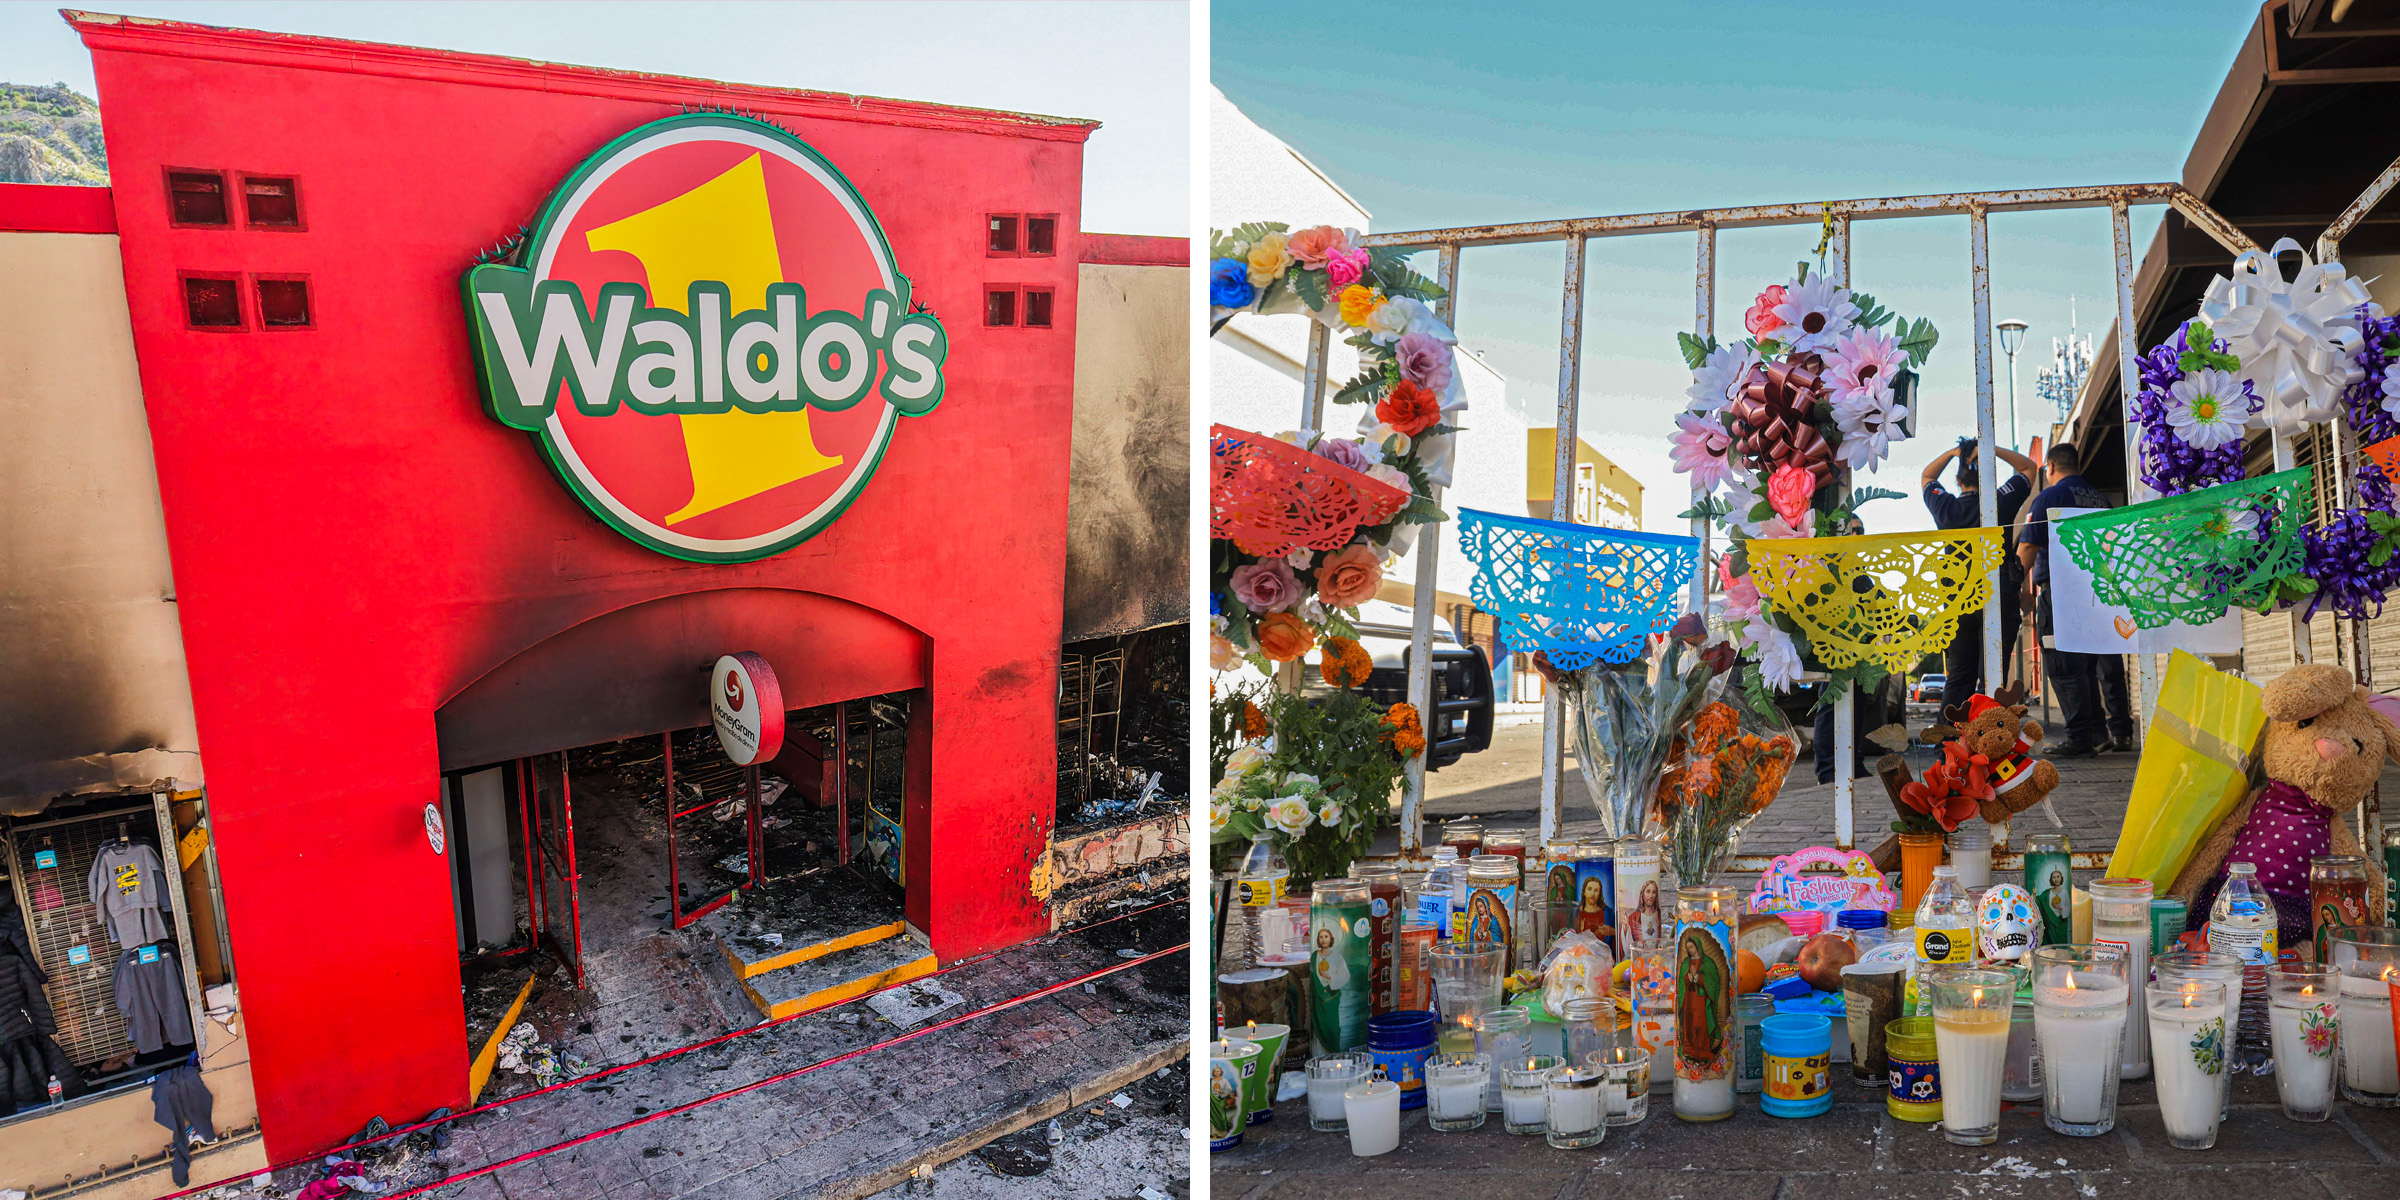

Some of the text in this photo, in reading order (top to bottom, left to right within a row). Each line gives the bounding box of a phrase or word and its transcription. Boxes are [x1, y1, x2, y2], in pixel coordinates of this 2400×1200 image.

[585, 151, 843, 526] 1
[477, 292, 938, 407] Waldo's
[714, 703, 755, 741] MoneyGram
[1796, 850, 1828, 865] Beauty
[1789, 877, 1854, 902] Fashion
[1817, 892, 1851, 904] Dress up
[1925, 942, 1949, 950] Grand
[1244, 1062, 1256, 1077] 12
